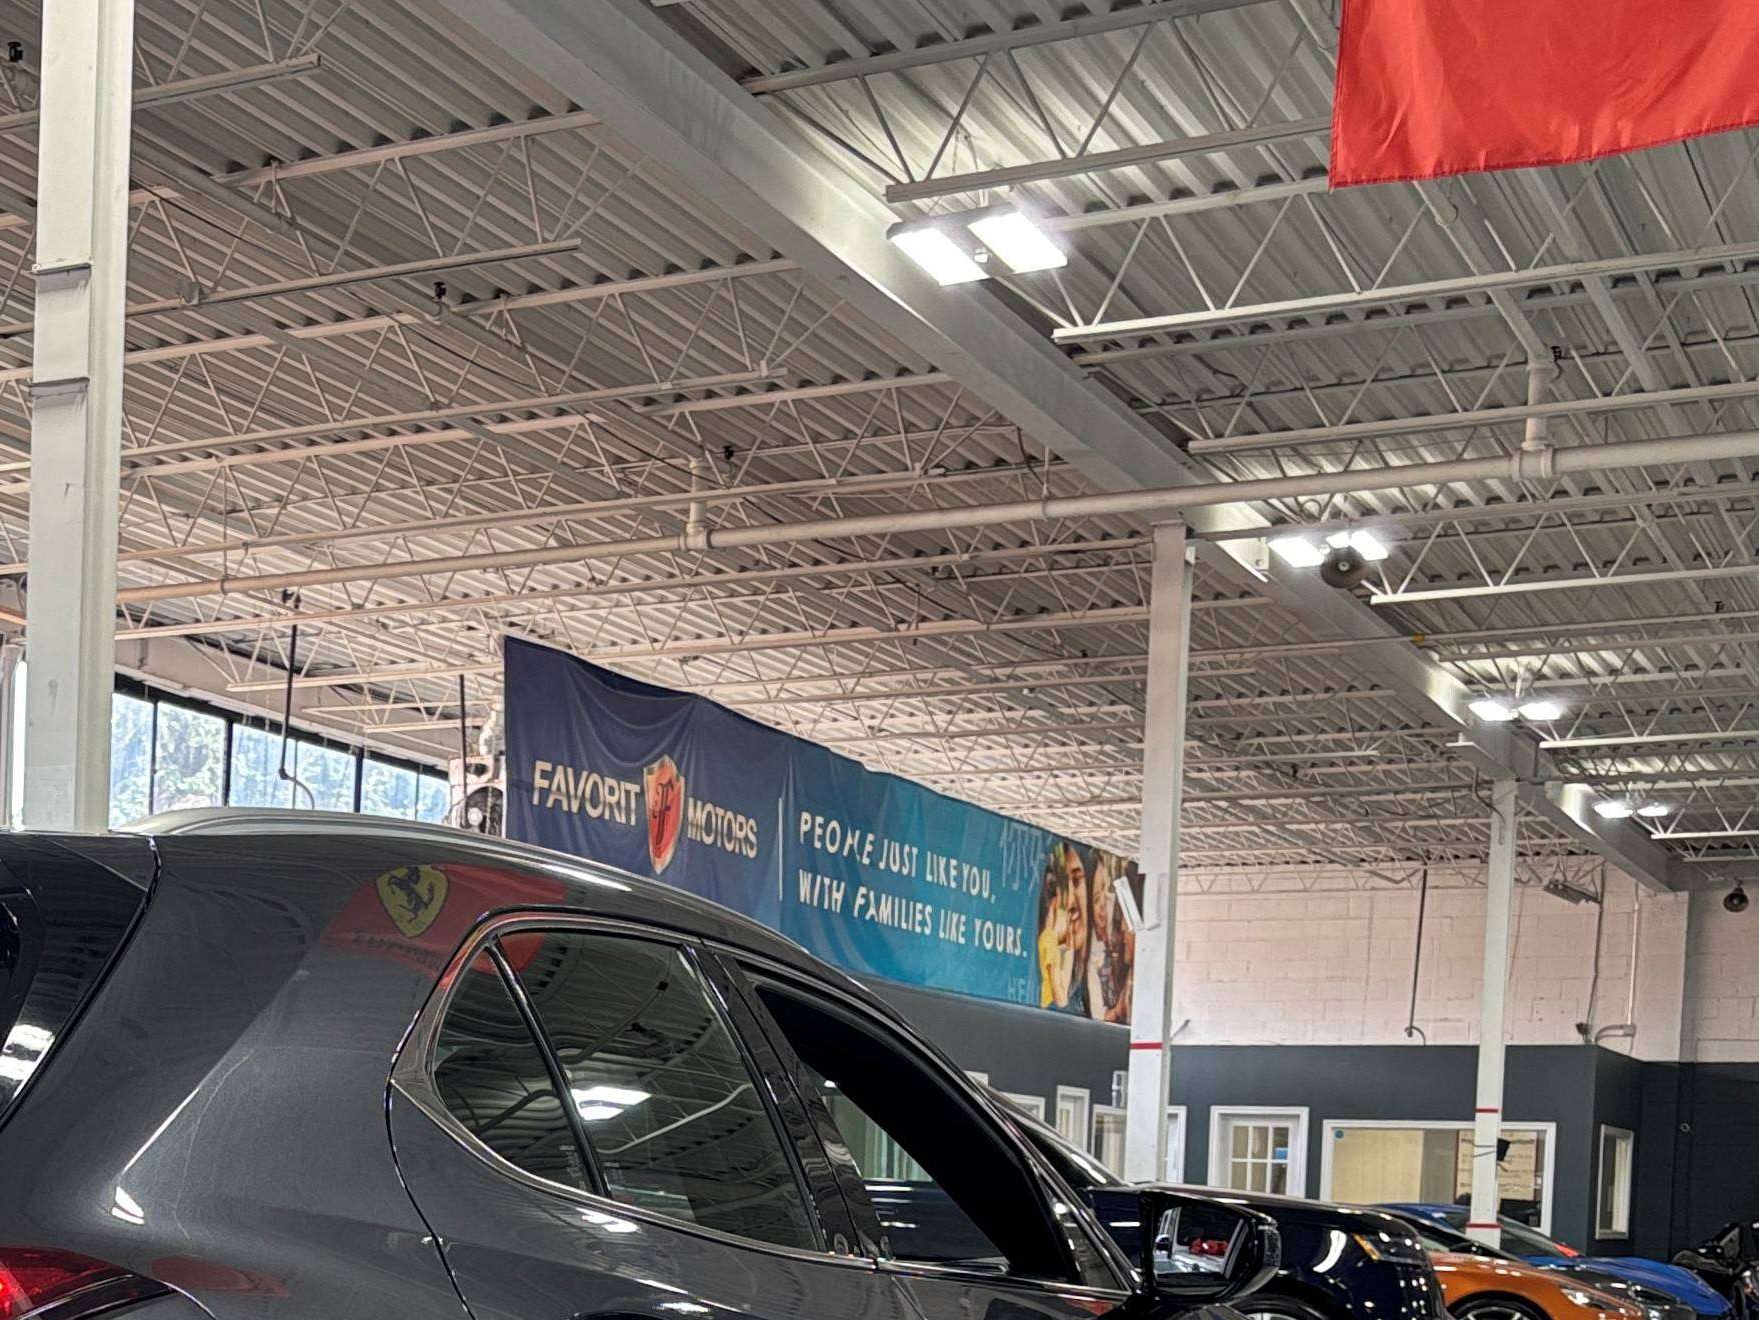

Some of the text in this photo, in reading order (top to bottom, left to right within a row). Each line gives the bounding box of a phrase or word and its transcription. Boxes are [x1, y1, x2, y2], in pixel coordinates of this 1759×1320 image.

[533, 760, 640, 826] FAVORIT
[688, 797, 758, 859] MOTORS
[800, 811, 996, 904] PEOPLE JUST LIKE YOU.
[799, 869, 1027, 958] WITH FAMILIES LIKE YOURS.
